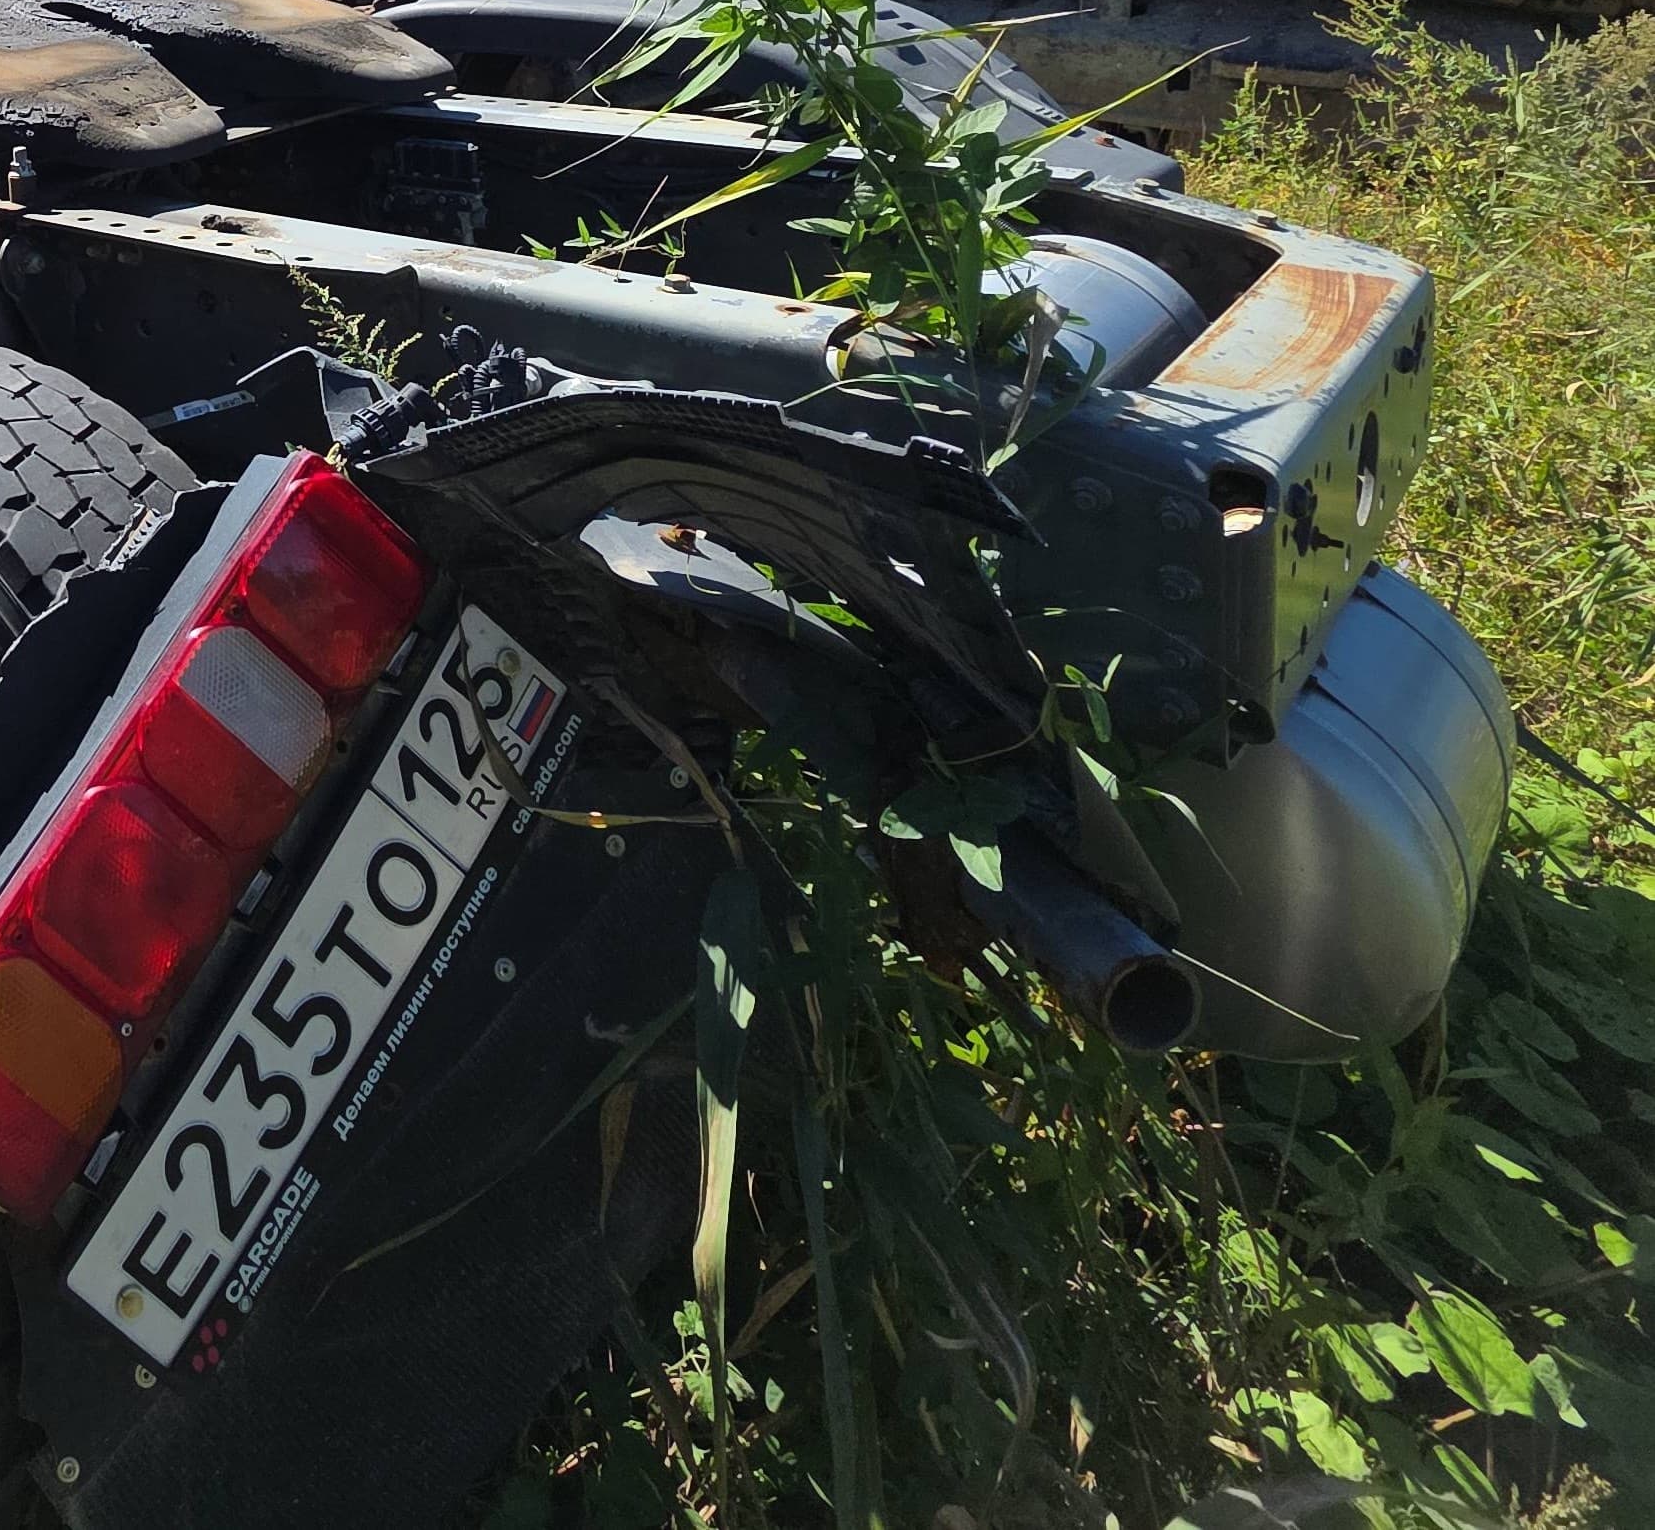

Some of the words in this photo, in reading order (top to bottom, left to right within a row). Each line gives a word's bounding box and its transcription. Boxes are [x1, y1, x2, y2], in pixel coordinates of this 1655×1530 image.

[398, 638, 514, 807] 125
[512, 713, 582, 835] caade.com
[332, 1050, 391, 1142] Делаем
[386, 973, 434, 1053] лизинг
[431, 866, 498, 978] доступнее
[225, 1166, 314, 1304] CARCADE
